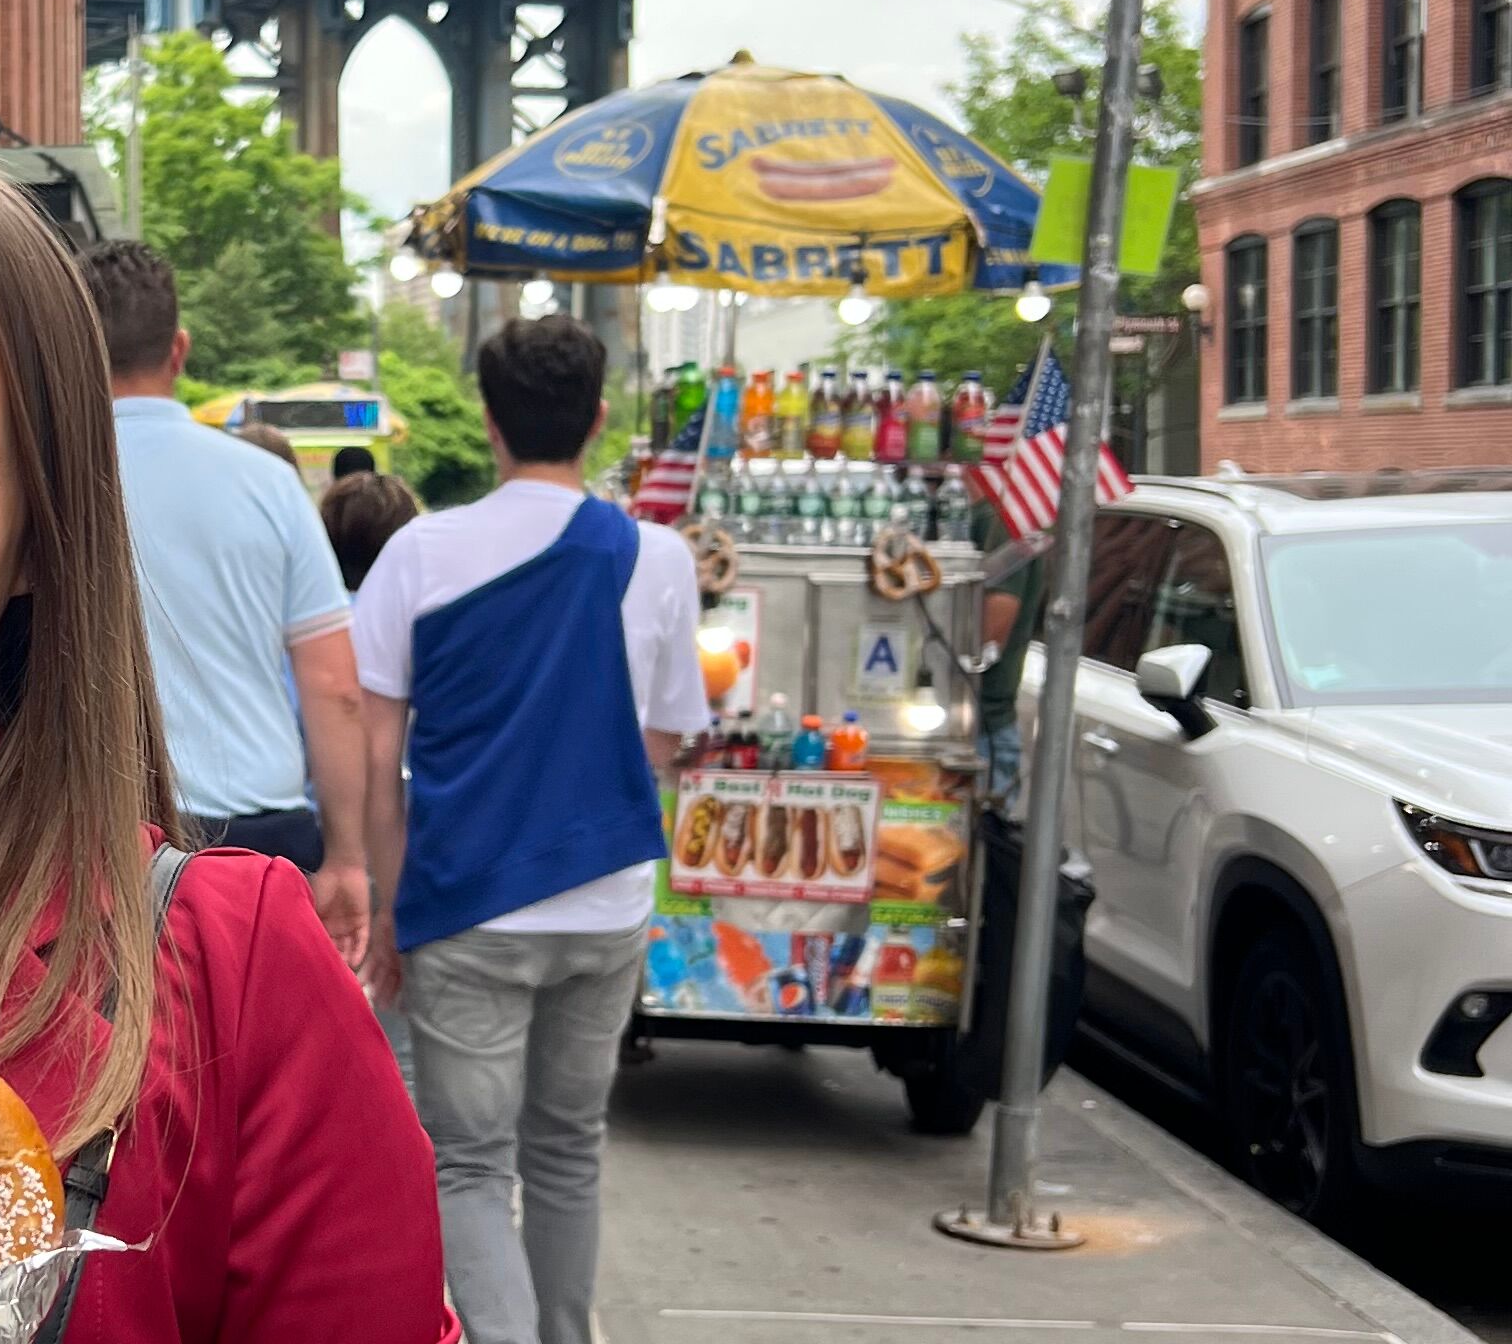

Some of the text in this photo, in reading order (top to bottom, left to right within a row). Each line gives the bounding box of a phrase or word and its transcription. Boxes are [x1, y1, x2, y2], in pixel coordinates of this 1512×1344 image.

[696, 118, 872, 171] SABRETT
[675, 231, 952, 281] SABRETT
[864, 634, 899, 673] A
